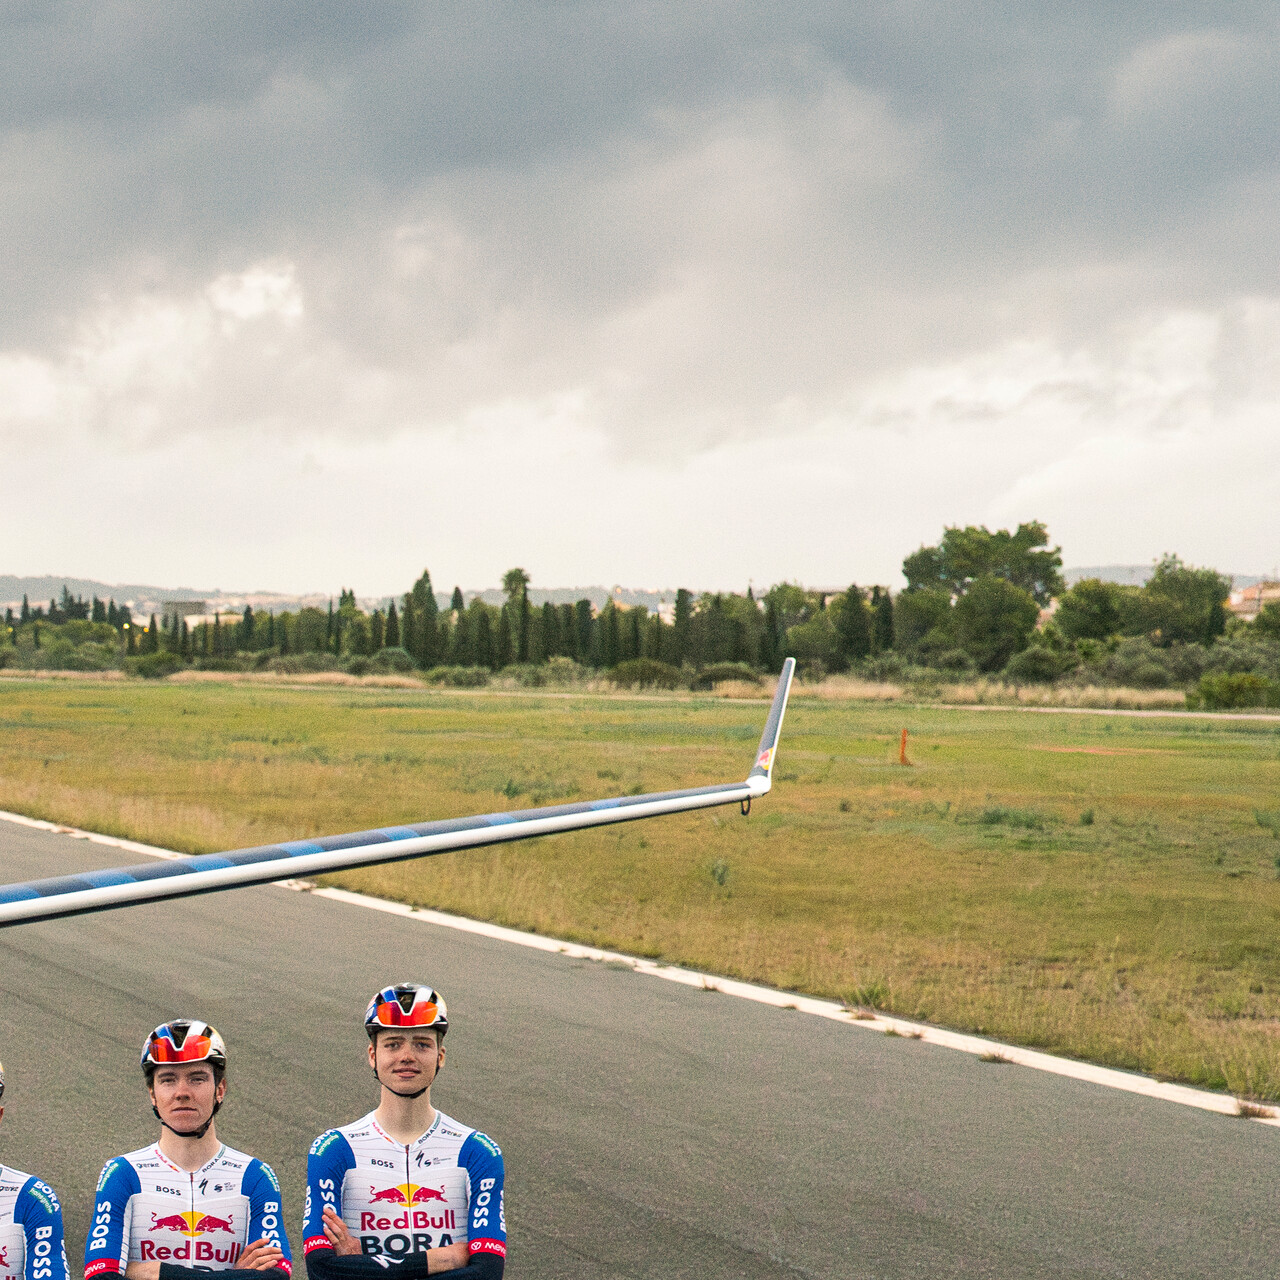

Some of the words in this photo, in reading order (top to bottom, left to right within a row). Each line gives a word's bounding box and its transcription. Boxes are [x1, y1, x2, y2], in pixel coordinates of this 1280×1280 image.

[371, 1159, 395, 1169] BOSS
[33, 1180, 60, 1212] BORA
[155, 1185, 182, 1196] BOSS
[319, 1178, 337, 1215] OSS
[473, 1178, 496, 1229] BOSS
[89, 1200, 112, 1251] BOSS
[360, 1211, 410, 1231] Red
[413, 1209, 456, 1230] Bull
[32, 1226, 53, 1280] BOSS
[140, 1240, 191, 1261] Red
[195, 1241, 240, 1264] Bull
